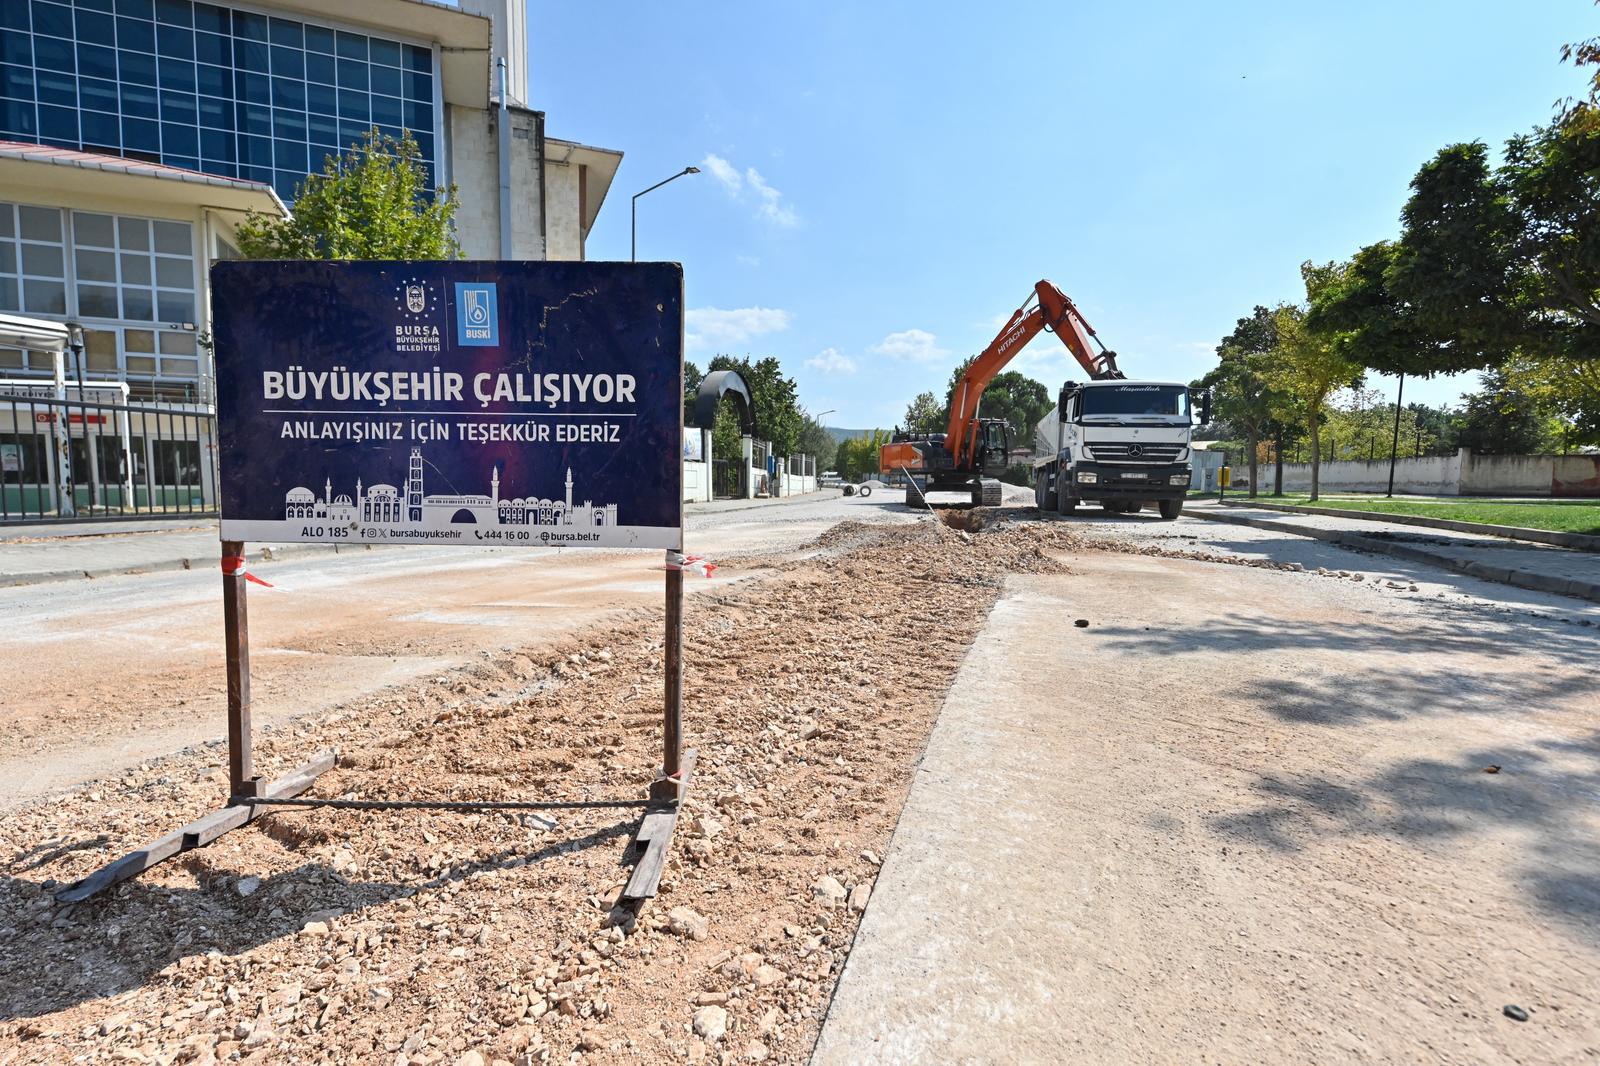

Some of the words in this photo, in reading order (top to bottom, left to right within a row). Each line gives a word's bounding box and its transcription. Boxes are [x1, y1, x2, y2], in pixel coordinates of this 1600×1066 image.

[395, 325, 440, 336] BURSA
[466, 329, 491, 339] BUSKİ
[396, 335, 440, 344] BÜYÜKŞEHİR
[997, 325, 1026, 355] HITACHI
[396, 343, 441, 352] BELEDİYESİ
[263, 366, 464, 406] BÜYÜKŞEHİR
[473, 372, 636, 408] ÇALIŞIYOR
[4, 390, 56, 399] BELEDİYES
[281, 421, 403, 443] ANLAYIŞINIZ
[411, 419, 449, 443] İÇİN
[456, 421, 550, 444] TEŞEKKÜR
[556, 421, 620, 442] EDERİZ
[301, 527, 324, 537] ALO
[328, 527, 349, 538] 185
[390, 529, 462, 539] bursabuyuksehir
[484, 530, 501, 539] 444
[504, 531, 515, 540] 16
[517, 531, 530, 540] 00
[551, 532, 600, 541] bursa.bel.tr
